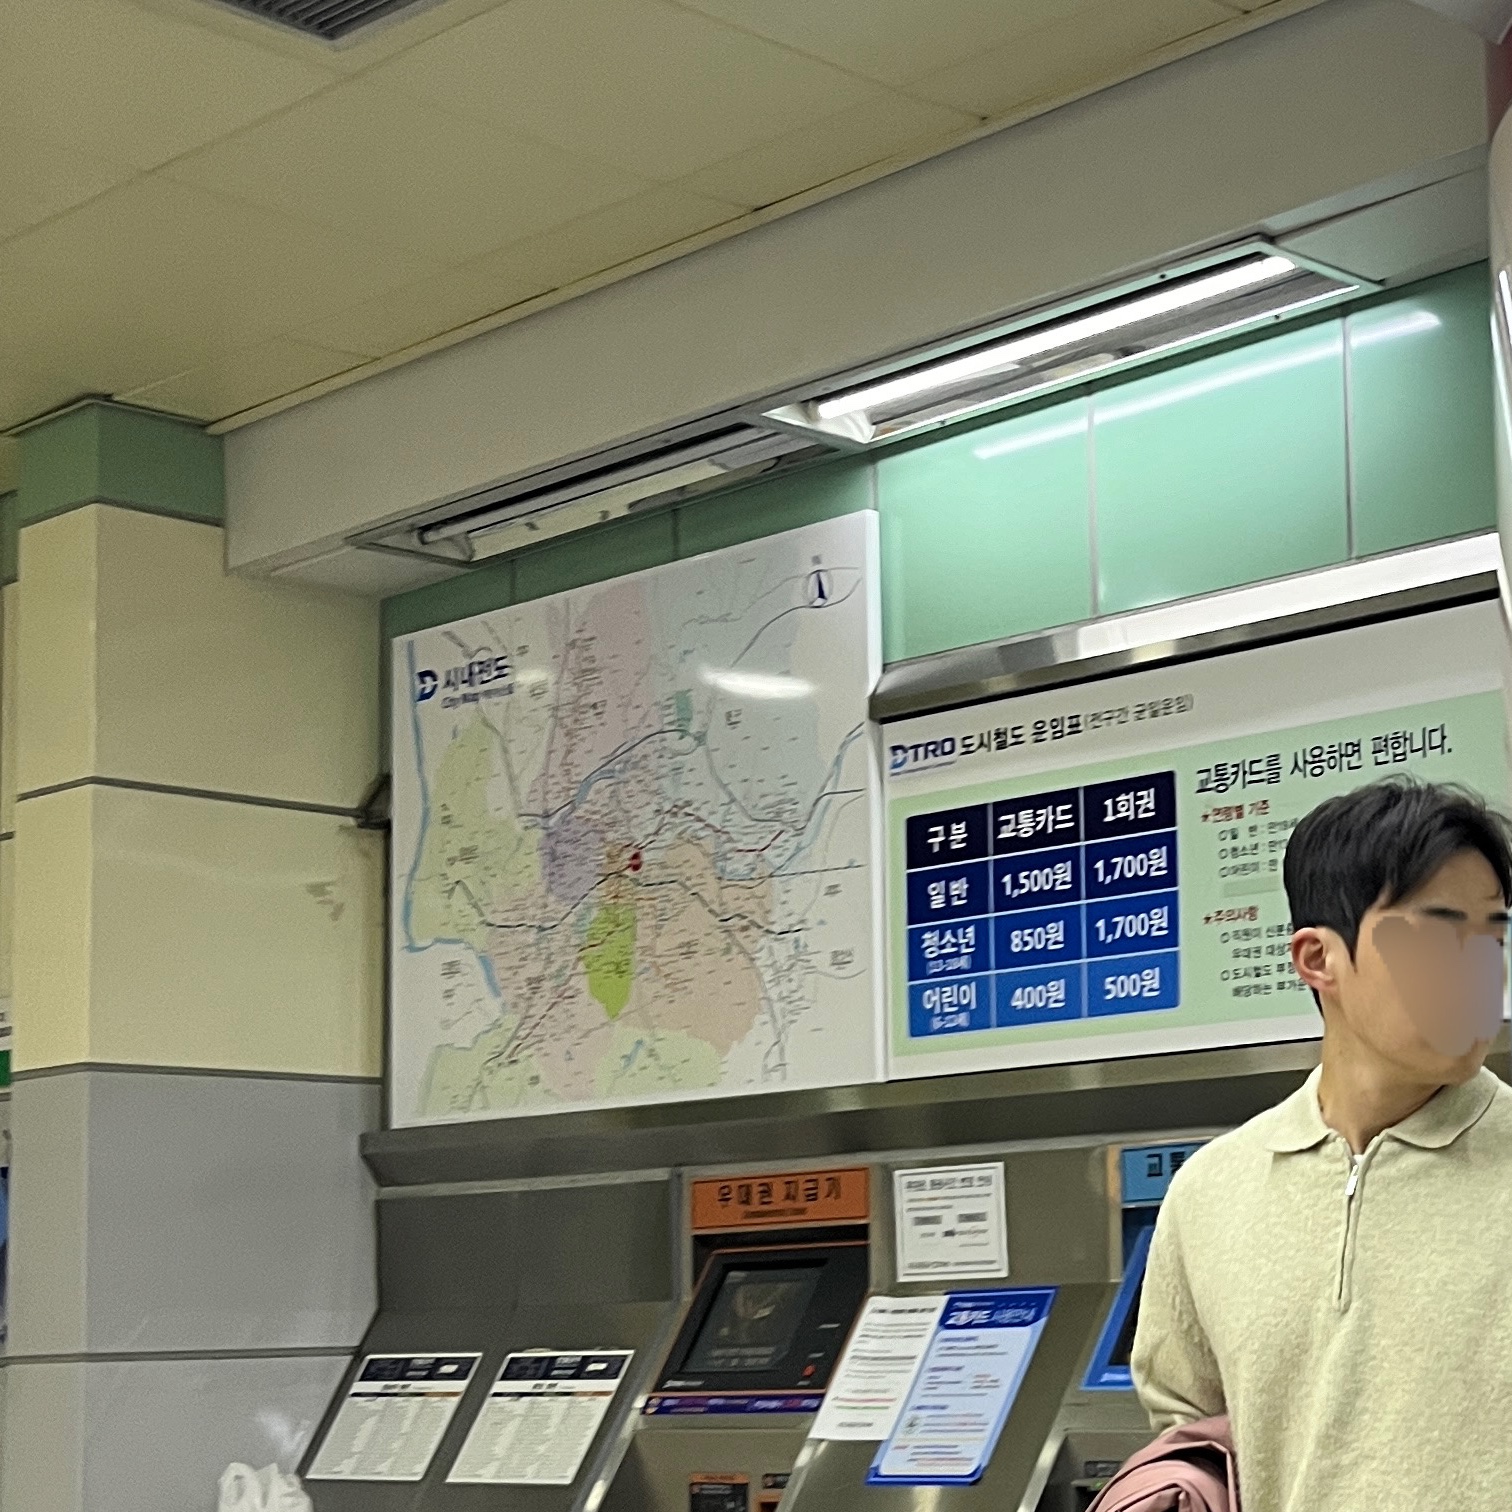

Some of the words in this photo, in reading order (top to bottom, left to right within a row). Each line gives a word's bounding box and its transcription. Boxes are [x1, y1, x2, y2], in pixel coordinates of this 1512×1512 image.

[959, 725, 1026, 757] 도시철도
[1030, 714, 1083, 744] 운임표
[1195, 753, 1282, 794] 교통카드를
[1290, 738, 1362, 779] 사용하면
[1371, 723, 1453, 766] 편합니다.
[927, 821, 968, 853] 구분
[996, 804, 1075, 839] 교통카드
[1103, 788, 1156, 823] 1회권
[927, 877, 969, 909] 일반
[1001, 861, 1073, 898] 1,500원
[1094, 846, 1168, 885] 1,700원
[921, 924, 976, 959] 청소년
[1010, 920, 1065, 953] 850원
[1095, 906, 1169, 945] 1,700원
[922, 981, 977, 1015] 어린이
[1010, 979, 1066, 1010] 400원
[1103, 967, 1161, 1000] 500원
[717, 1182, 774, 1209] 우대권
[784, 1175, 842, 1202] 지급기
